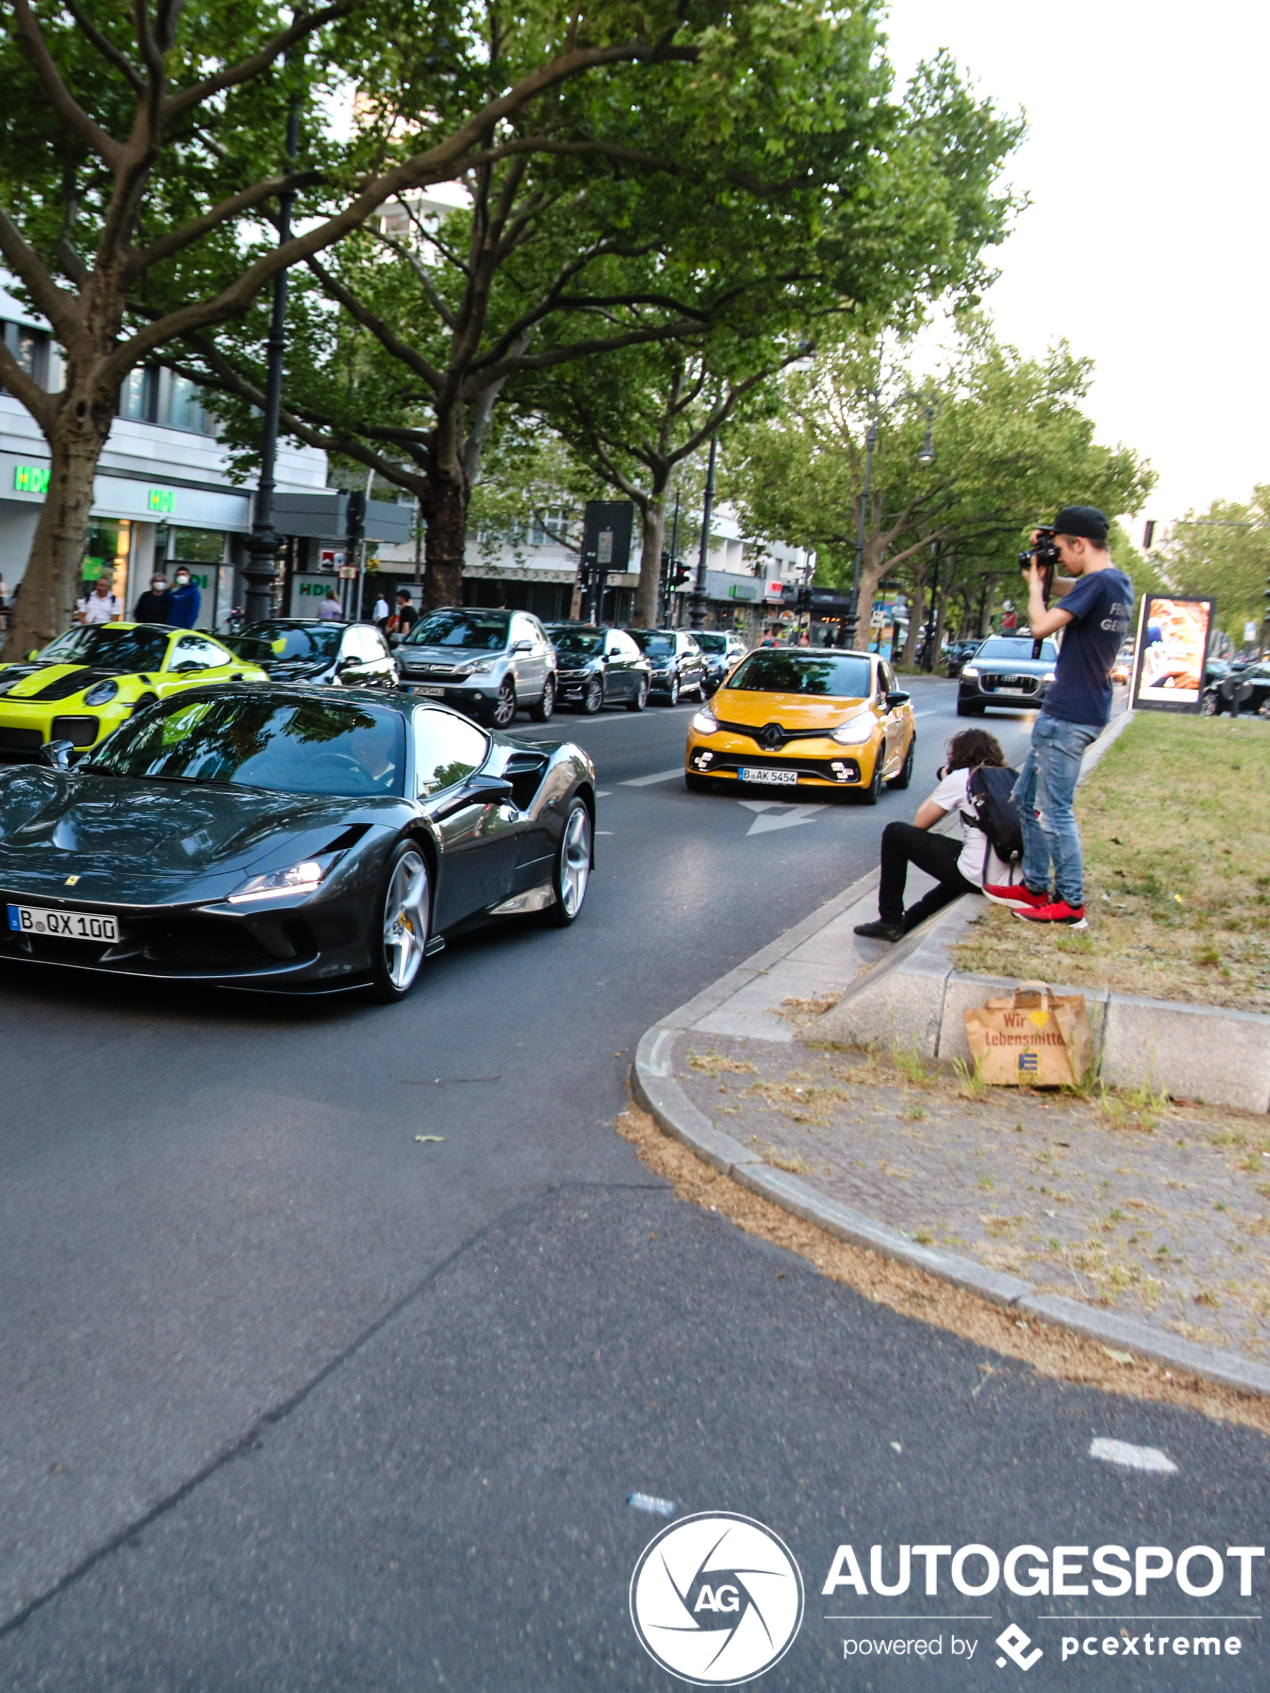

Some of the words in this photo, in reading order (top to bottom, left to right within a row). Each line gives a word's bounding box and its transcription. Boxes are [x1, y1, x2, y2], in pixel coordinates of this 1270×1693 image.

[149, 489, 175, 512] HDI
[175, 574, 208, 590] DI
[744, 770, 750, 779] B
[756, 772, 769, 780] AK
[771, 772, 796, 782] 5454
[21, 910, 33, 929] B
[46, 914, 73, 935] QX
[77, 917, 114, 938] 100
[1003, 1013, 1026, 1028] Wir
